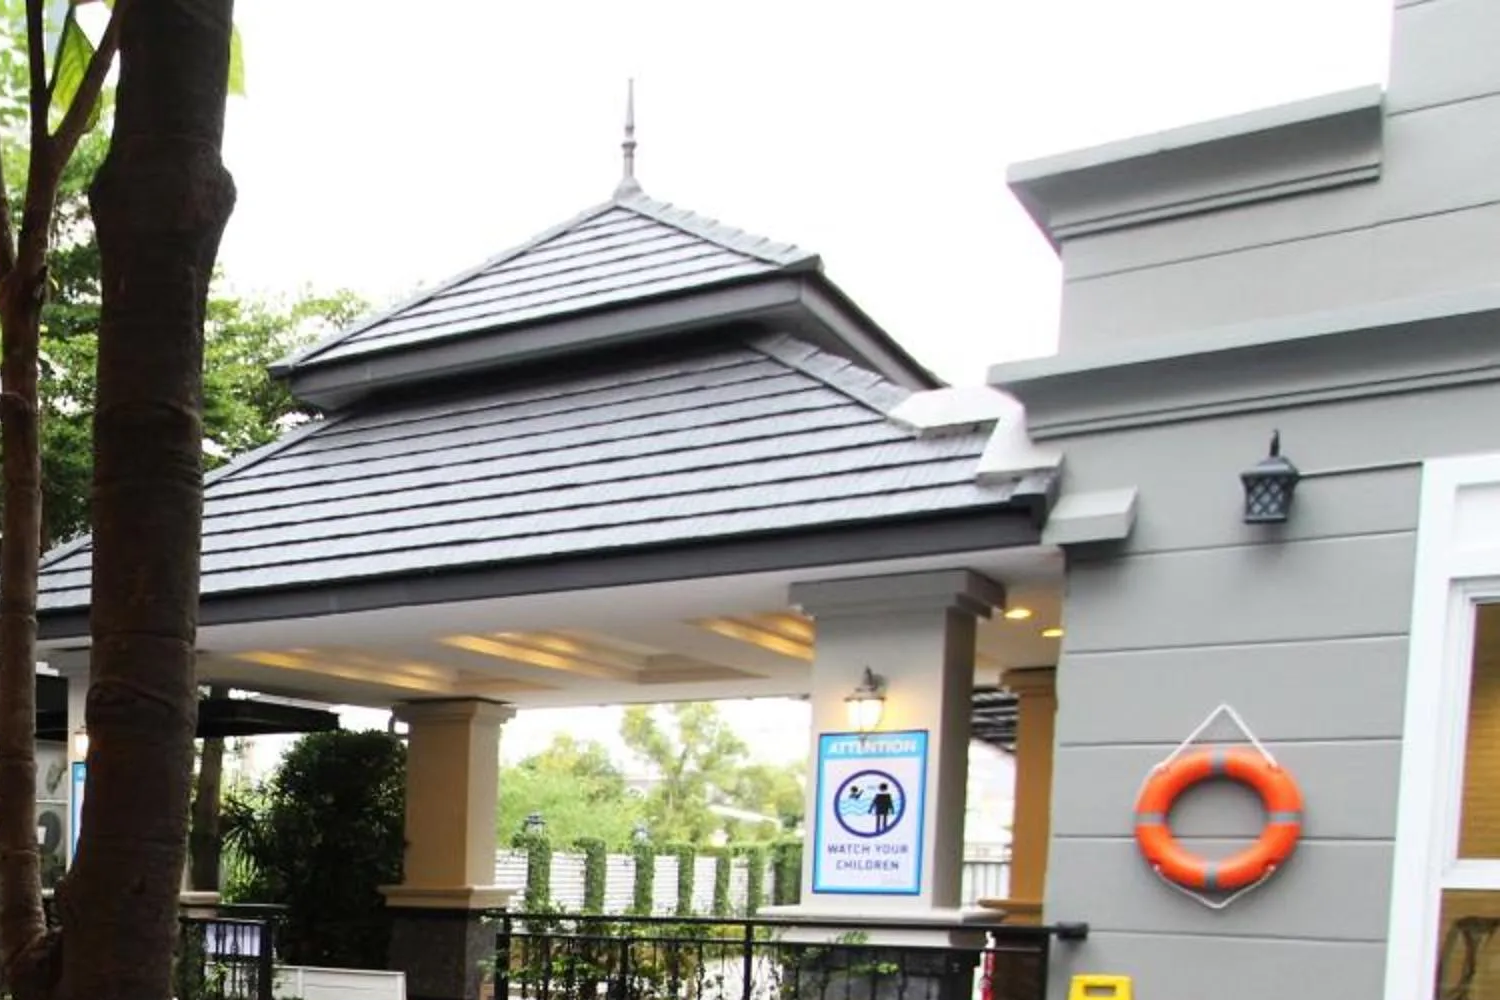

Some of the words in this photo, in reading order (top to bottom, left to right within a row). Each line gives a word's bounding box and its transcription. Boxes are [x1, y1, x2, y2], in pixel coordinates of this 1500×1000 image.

[828, 739, 917, 754] ATTENTION
[827, 843, 870, 854] WATCH
[874, 843, 909, 854] YOUR
[835, 859, 900, 871] CHILDREN
